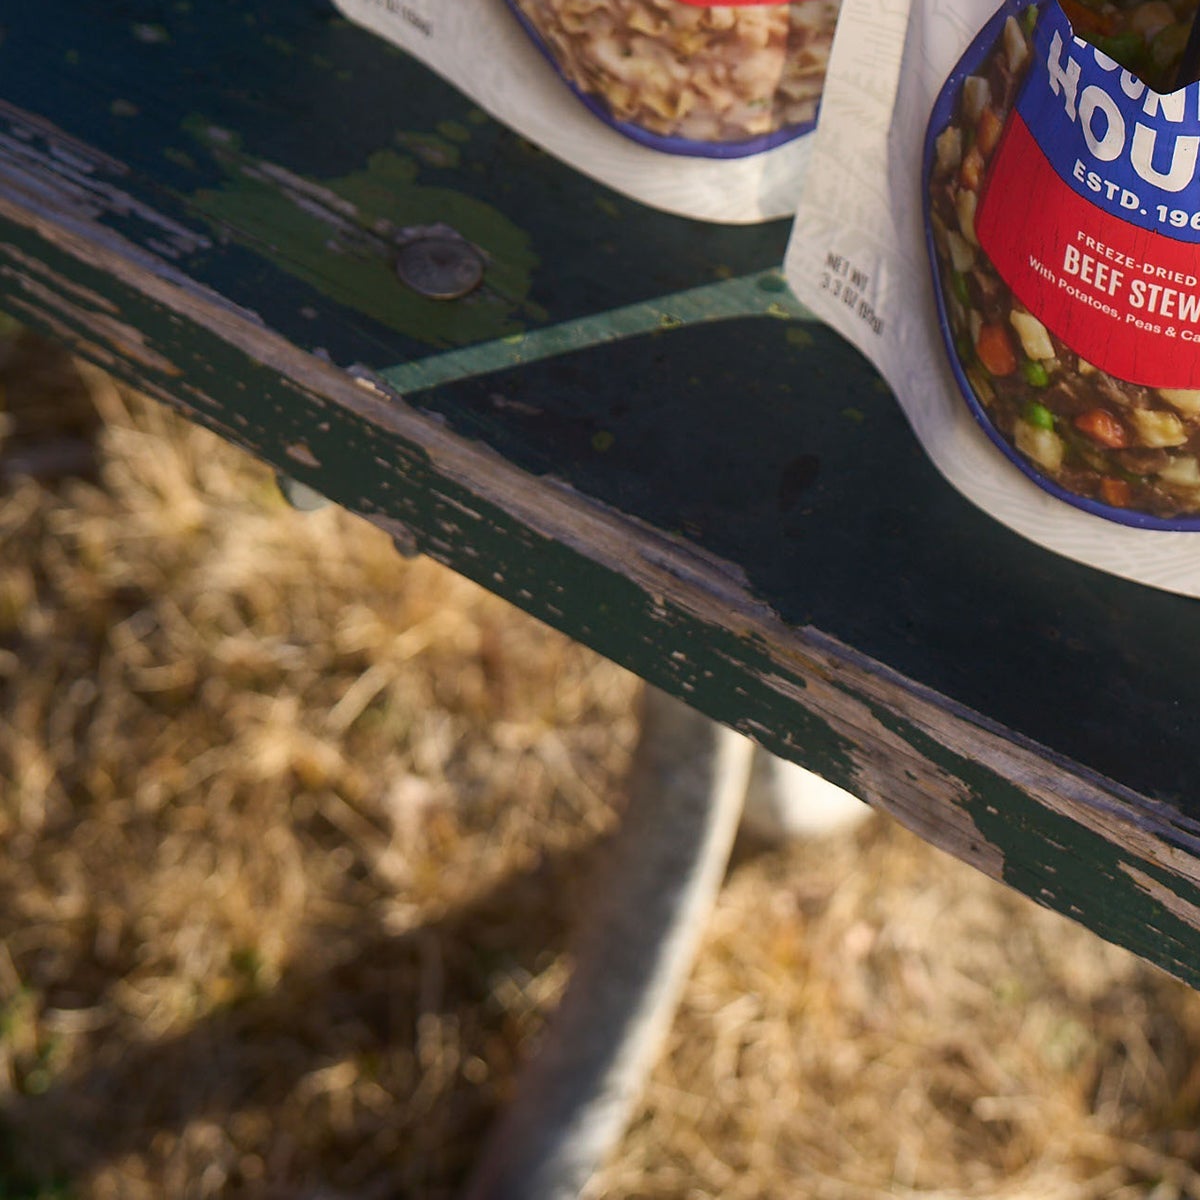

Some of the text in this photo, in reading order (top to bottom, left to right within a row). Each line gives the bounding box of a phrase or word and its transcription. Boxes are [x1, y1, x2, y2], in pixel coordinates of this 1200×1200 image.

[1072, 158, 1148, 216] ESTD.
[1063, 243, 1125, 297] BEEF
[1076, 230, 1198, 287] FREEZE-DRIED
[1029, 255, 1056, 284] With
[1058, 278, 1122, 321] Potatoes,
[1125, 313, 1162, 335] Peas
[1164, 326, 1177, 338] &
